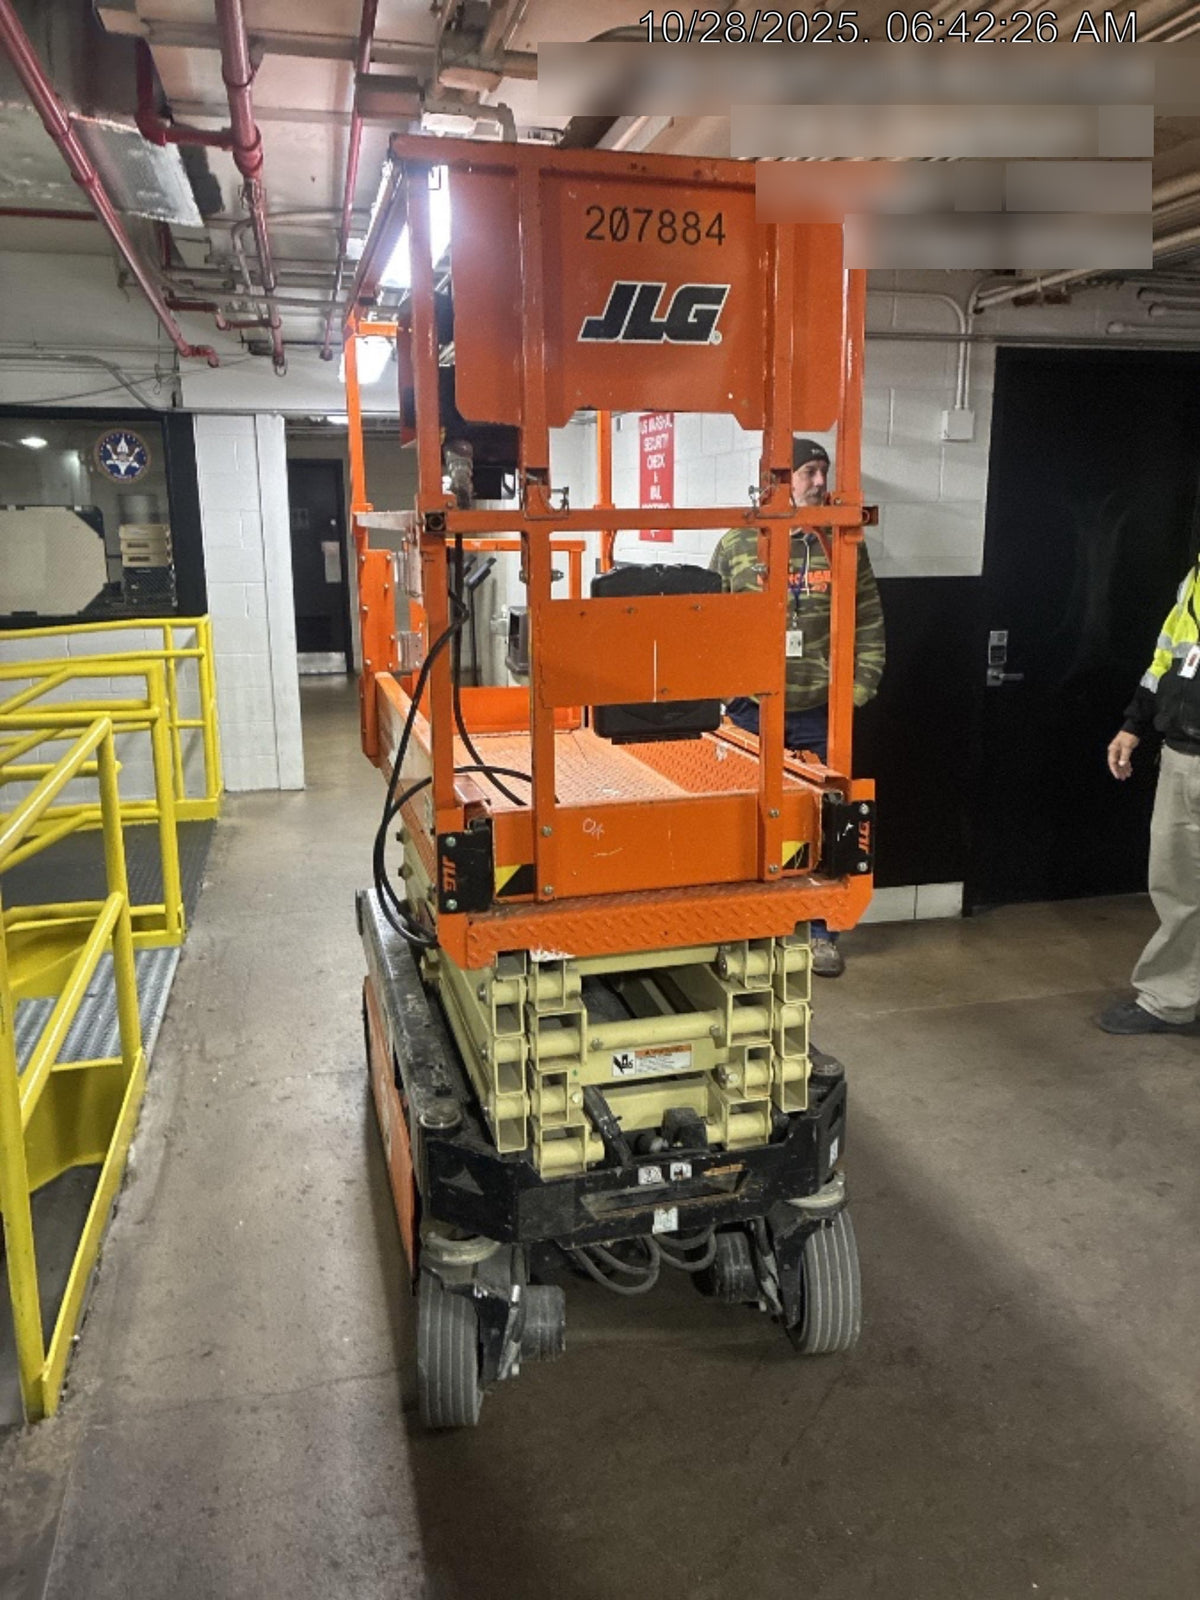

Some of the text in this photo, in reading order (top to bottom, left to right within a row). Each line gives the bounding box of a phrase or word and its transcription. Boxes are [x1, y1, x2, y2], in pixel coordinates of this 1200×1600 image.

[585, 205, 726, 246] 207884
[578, 281, 731, 345] JLG
[442, 853, 456, 893] JLG
